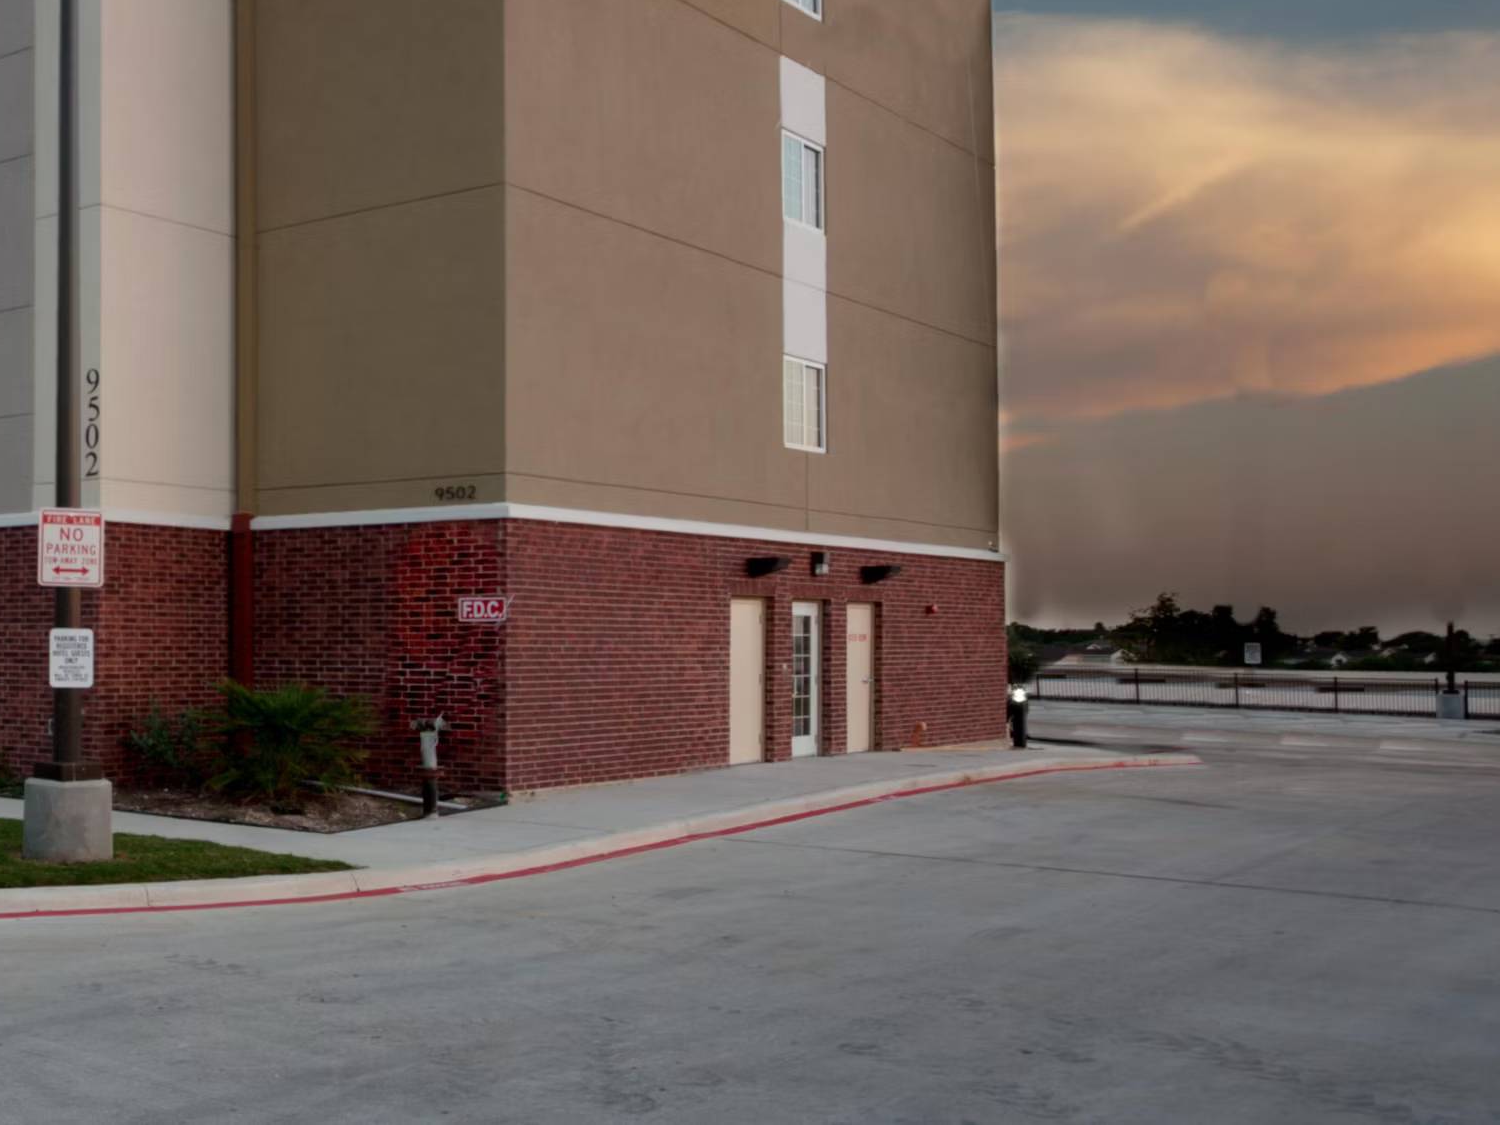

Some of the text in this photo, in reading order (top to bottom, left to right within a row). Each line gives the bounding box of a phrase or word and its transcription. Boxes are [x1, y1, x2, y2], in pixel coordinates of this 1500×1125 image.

[85, 368, 100, 477] 9502
[434, 486, 476, 501] 9502
[60, 527, 84, 542] NO
[46, 543, 96, 556] PARKING
[462, 601, 502, 619] F.D.C.
